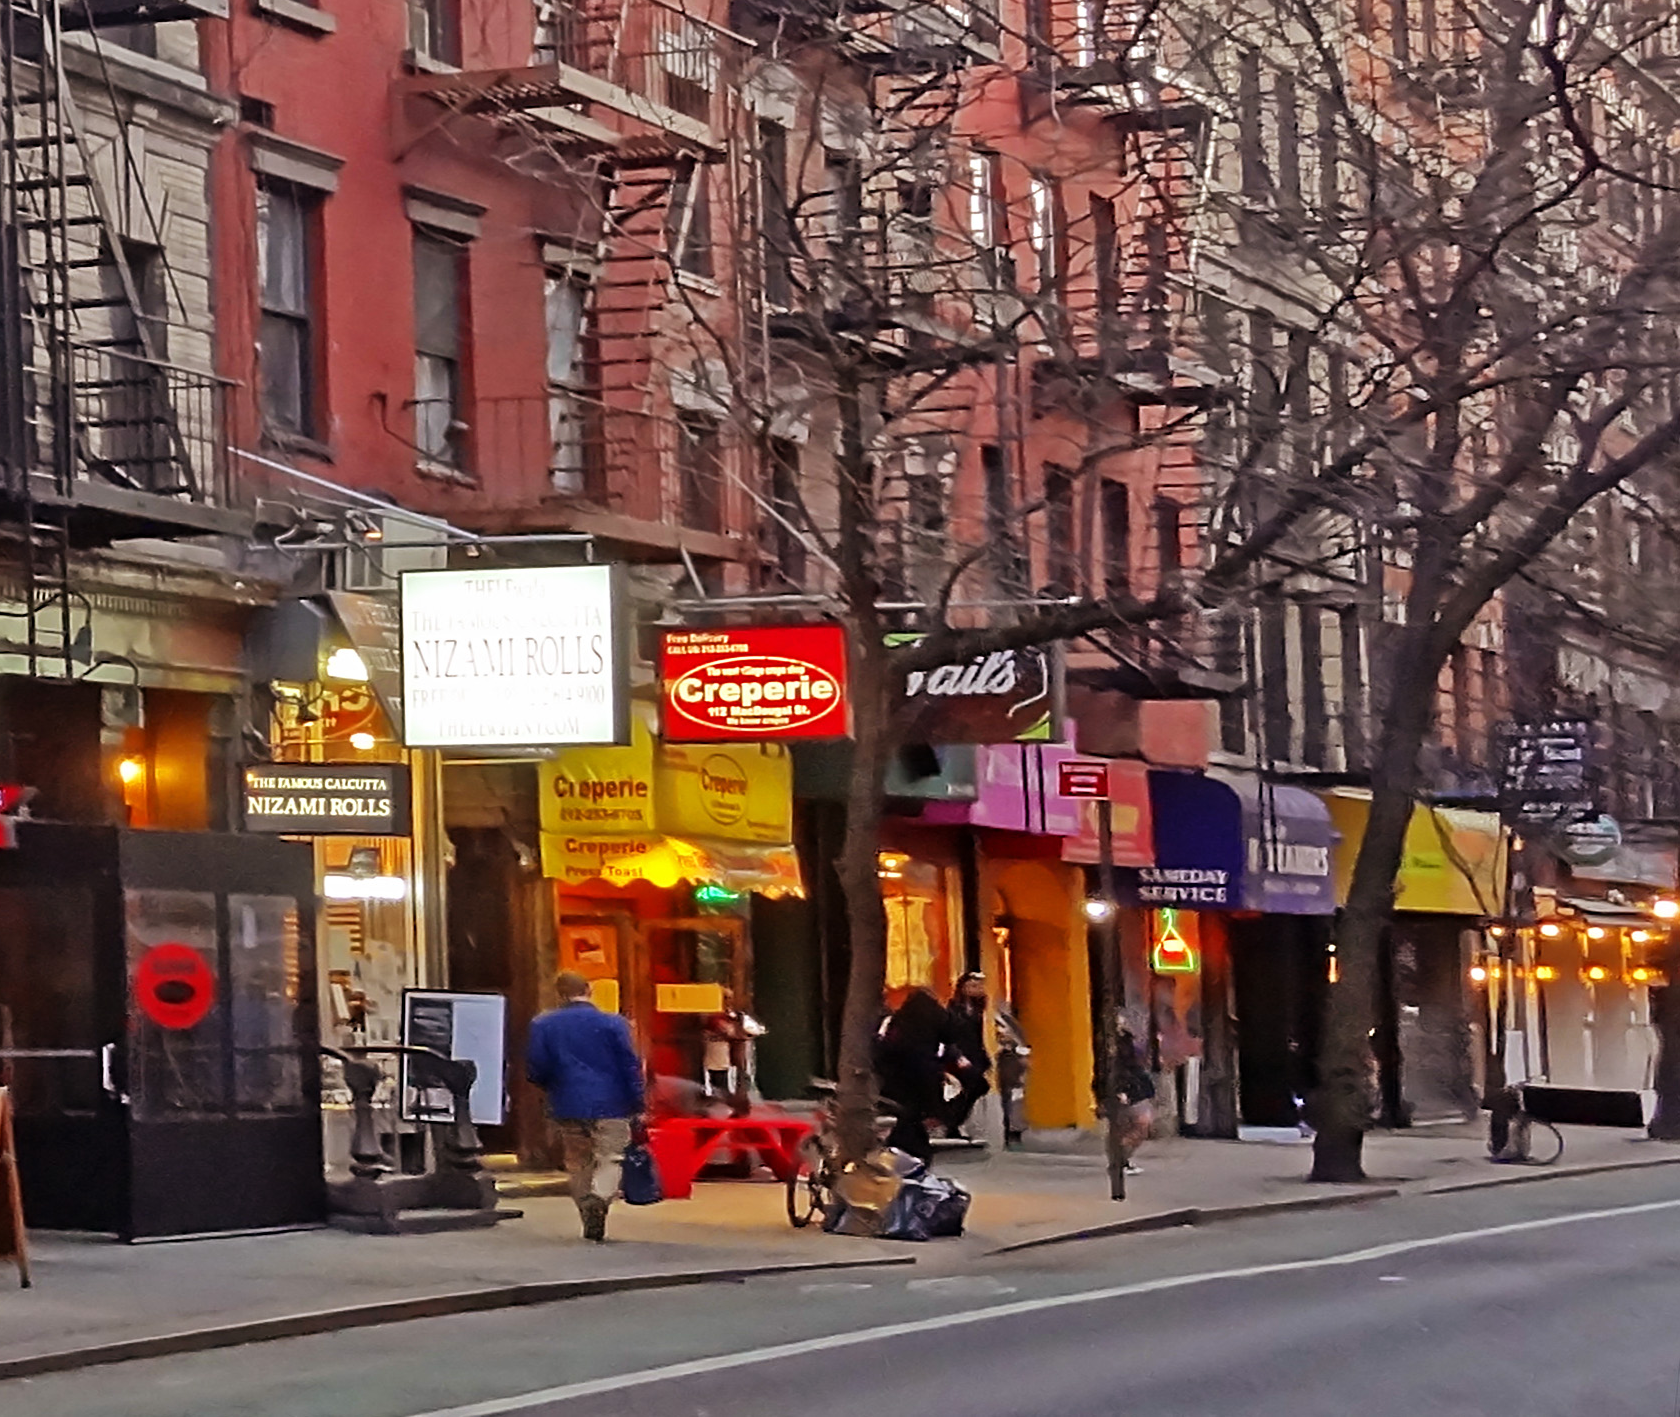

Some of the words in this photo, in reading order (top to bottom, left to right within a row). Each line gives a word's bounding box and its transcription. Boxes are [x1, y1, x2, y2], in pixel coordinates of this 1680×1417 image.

[412, 638, 515, 679] NIZAMI
[525, 634, 604, 676] ROLLS
[678, 675, 834, 707] Creperie
[253, 777, 275, 789] THE
[277, 777, 323, 790] FAMOUS
[324, 778, 387, 791] CALCUTTA
[553, 774, 648, 804] Creperie
[247, 796, 326, 816] NIZAMI
[329, 798, 391, 817] ROLLS
